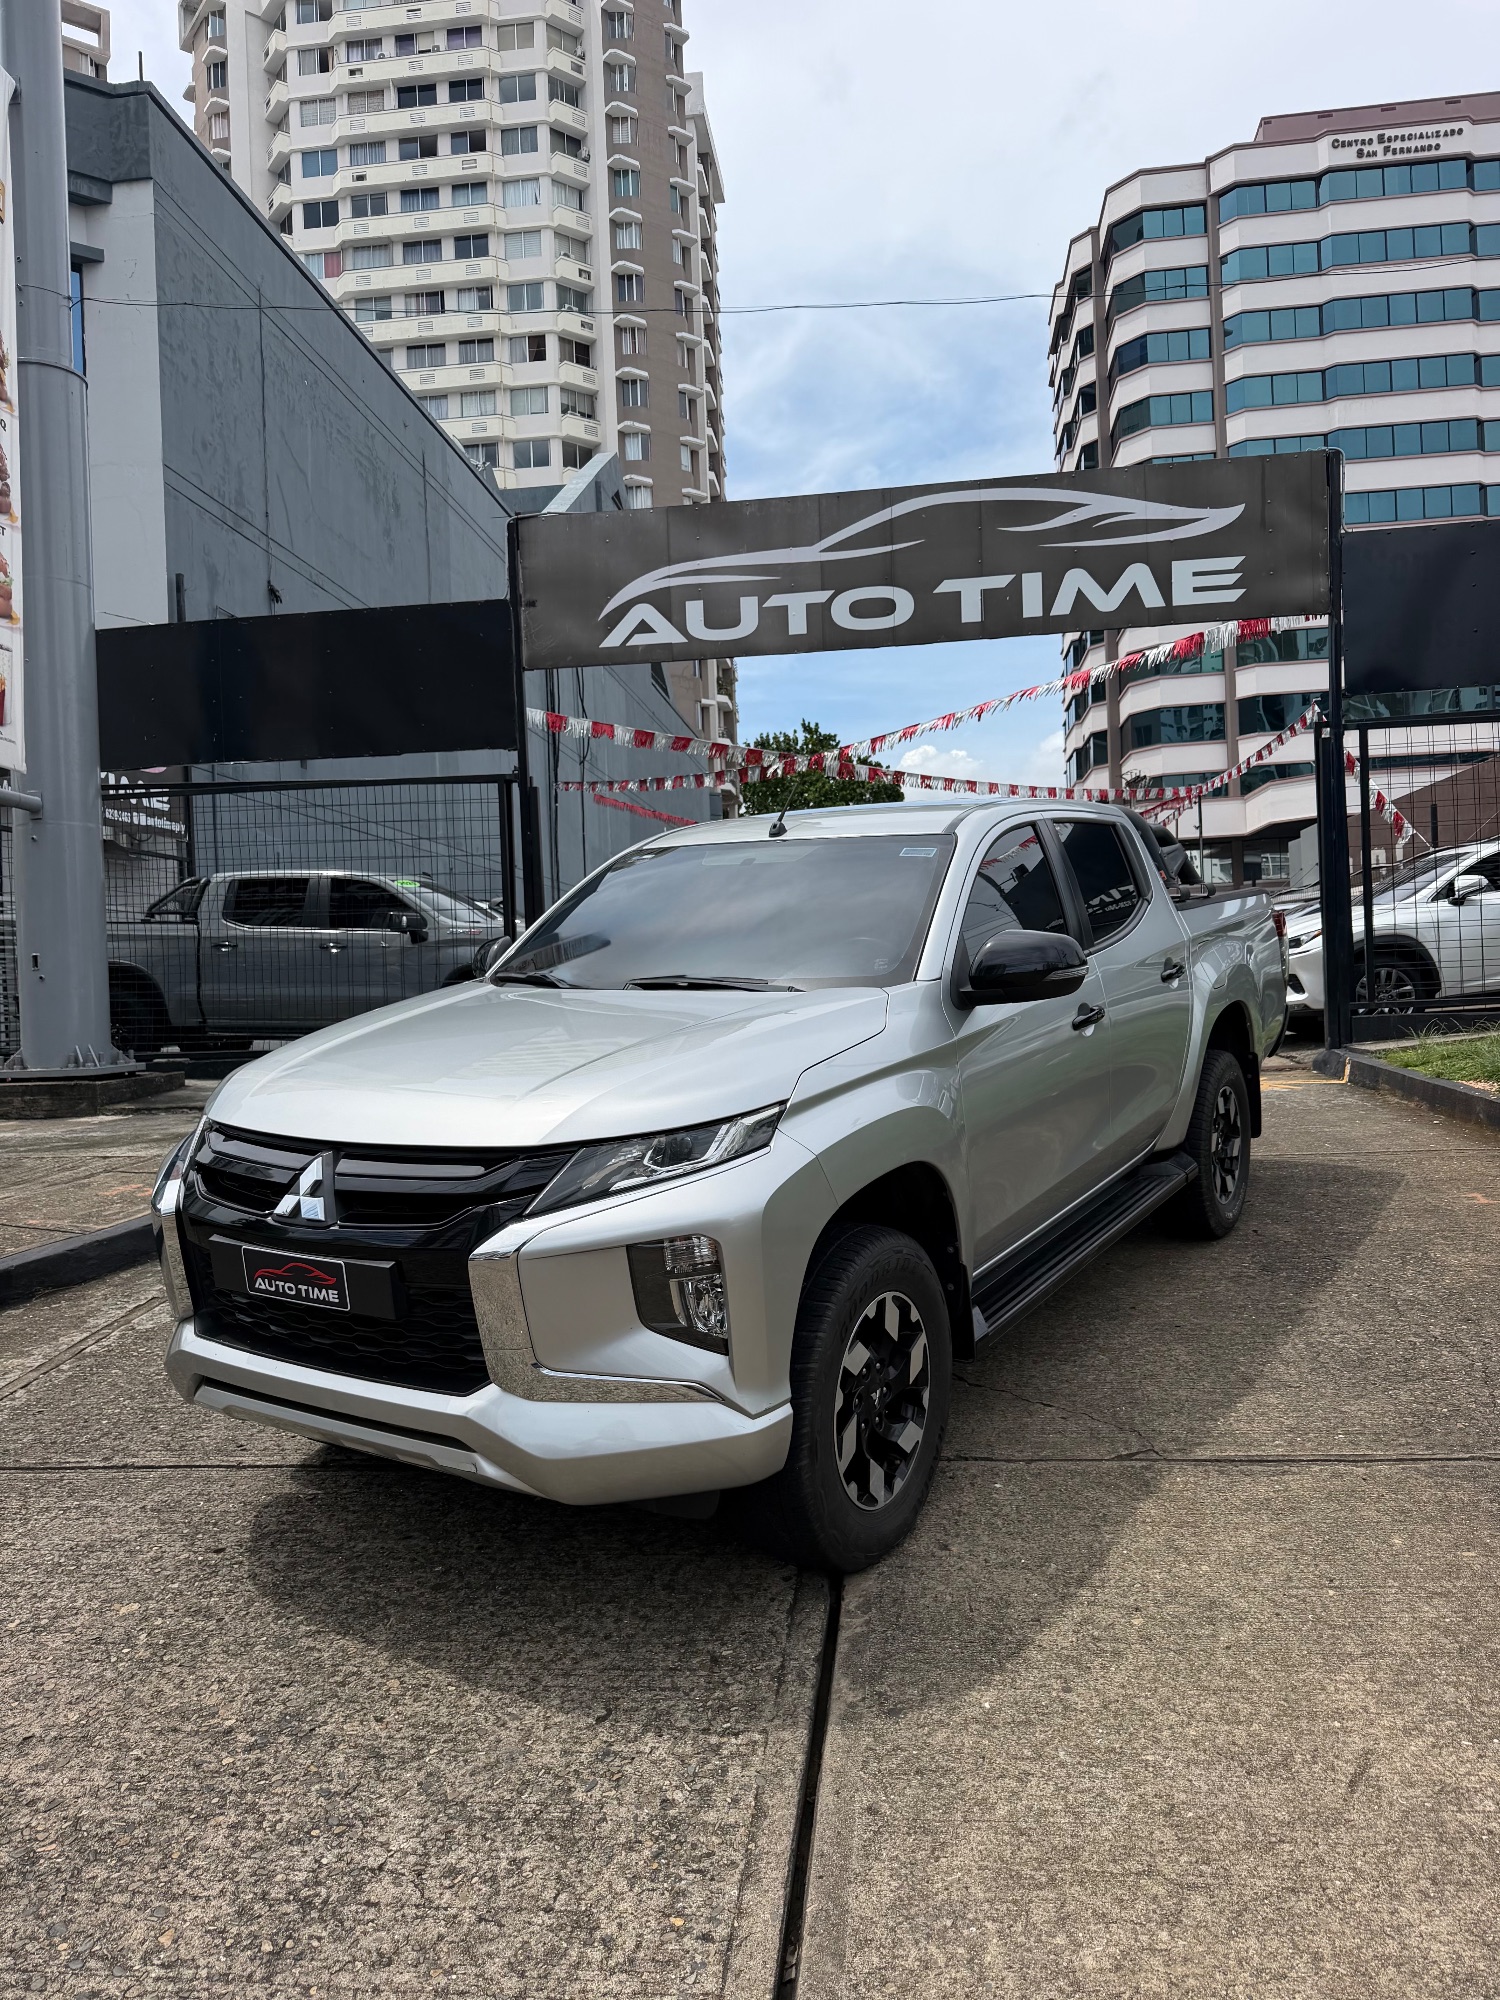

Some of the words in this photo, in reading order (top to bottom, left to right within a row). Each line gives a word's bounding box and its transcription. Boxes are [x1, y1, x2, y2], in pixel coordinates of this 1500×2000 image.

[1331, 137, 1374, 149] CENTRO
[1377, 127, 1464, 144] ESPECIALIZADO
[1356, 147, 1378, 158] SAN
[1383, 142, 1441, 156] FERNANDO
[599, 584, 915, 648] AUTO
[933, 556, 1247, 623] TIME
[254, 1277, 296, 1296] AUTO
[299, 1284, 340, 1304] TIME
